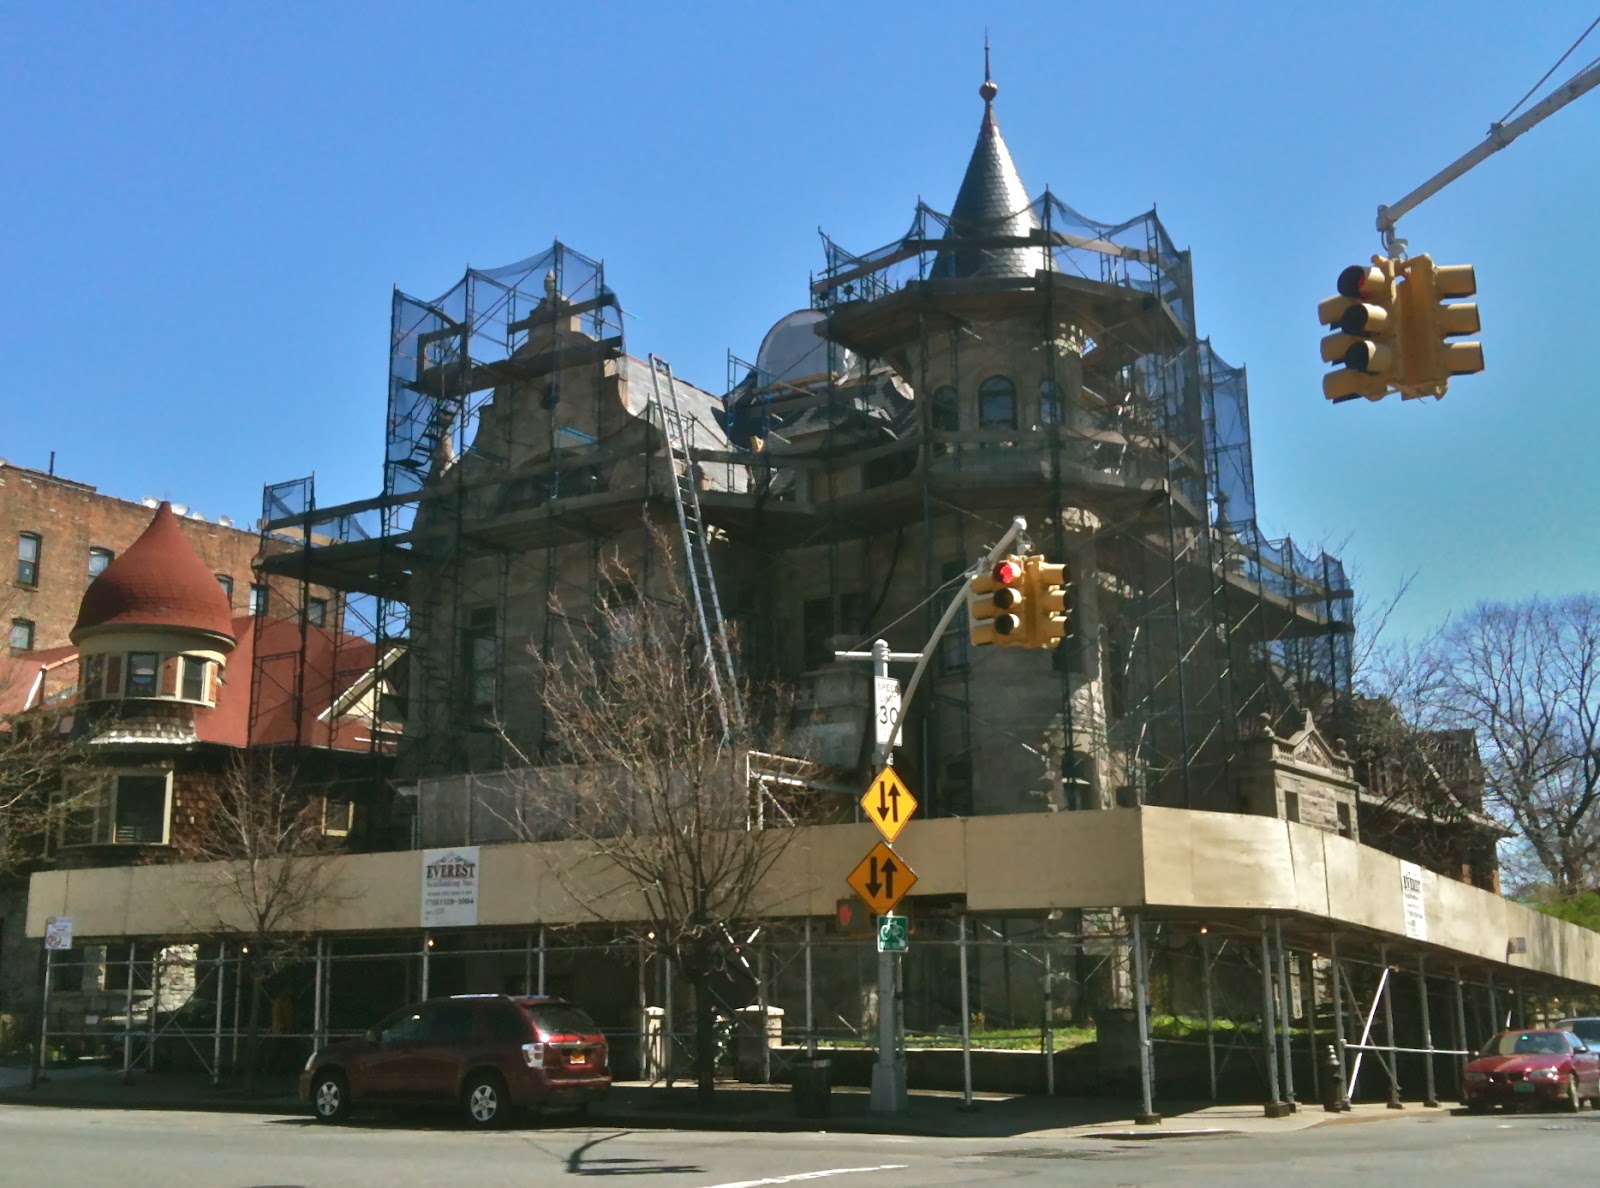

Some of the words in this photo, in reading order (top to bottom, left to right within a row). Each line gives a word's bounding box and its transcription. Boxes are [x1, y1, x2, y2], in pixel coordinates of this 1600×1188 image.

[878, 683, 899, 693] SPEED
[880, 705, 898, 725] 30
[426, 863, 476, 878] EVEREST
